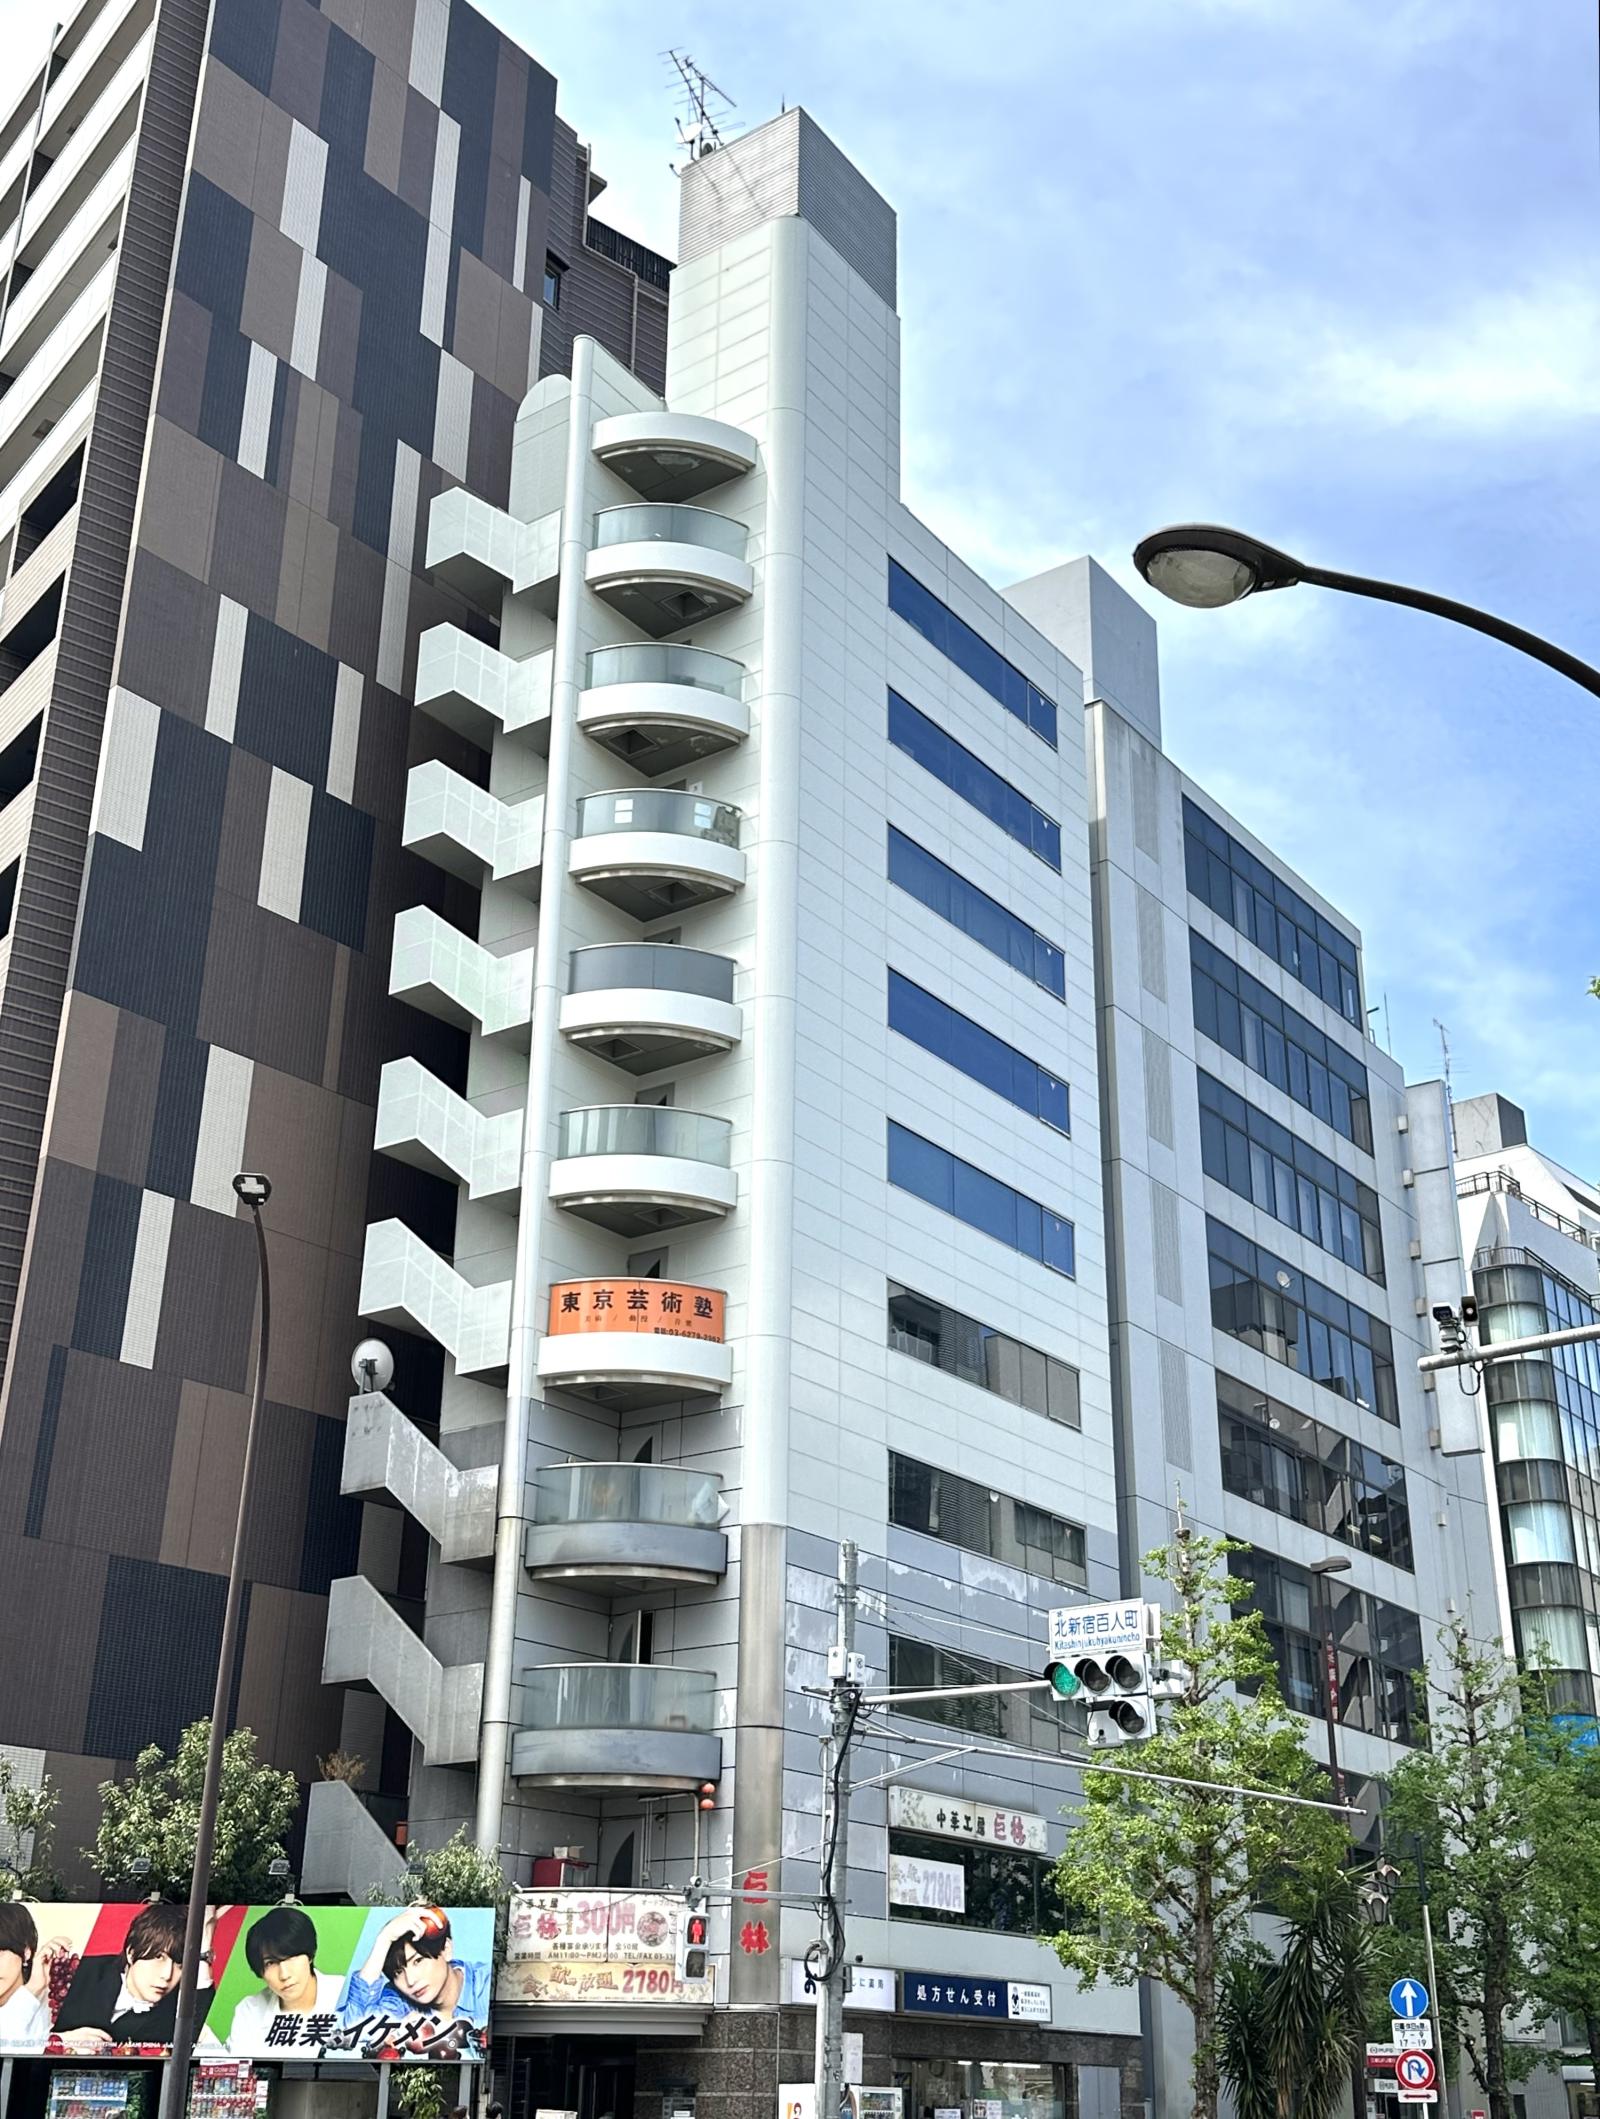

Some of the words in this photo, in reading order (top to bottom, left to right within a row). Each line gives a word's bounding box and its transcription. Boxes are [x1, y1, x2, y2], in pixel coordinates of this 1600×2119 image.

[561, 1289, 713, 1318] 東京芸術塾
[1054, 1610, 1138, 1637] 北新宿百人町
[937, 1808, 985, 1836] 中華工房
[917, 1984, 996, 2007] 処方せん受付
